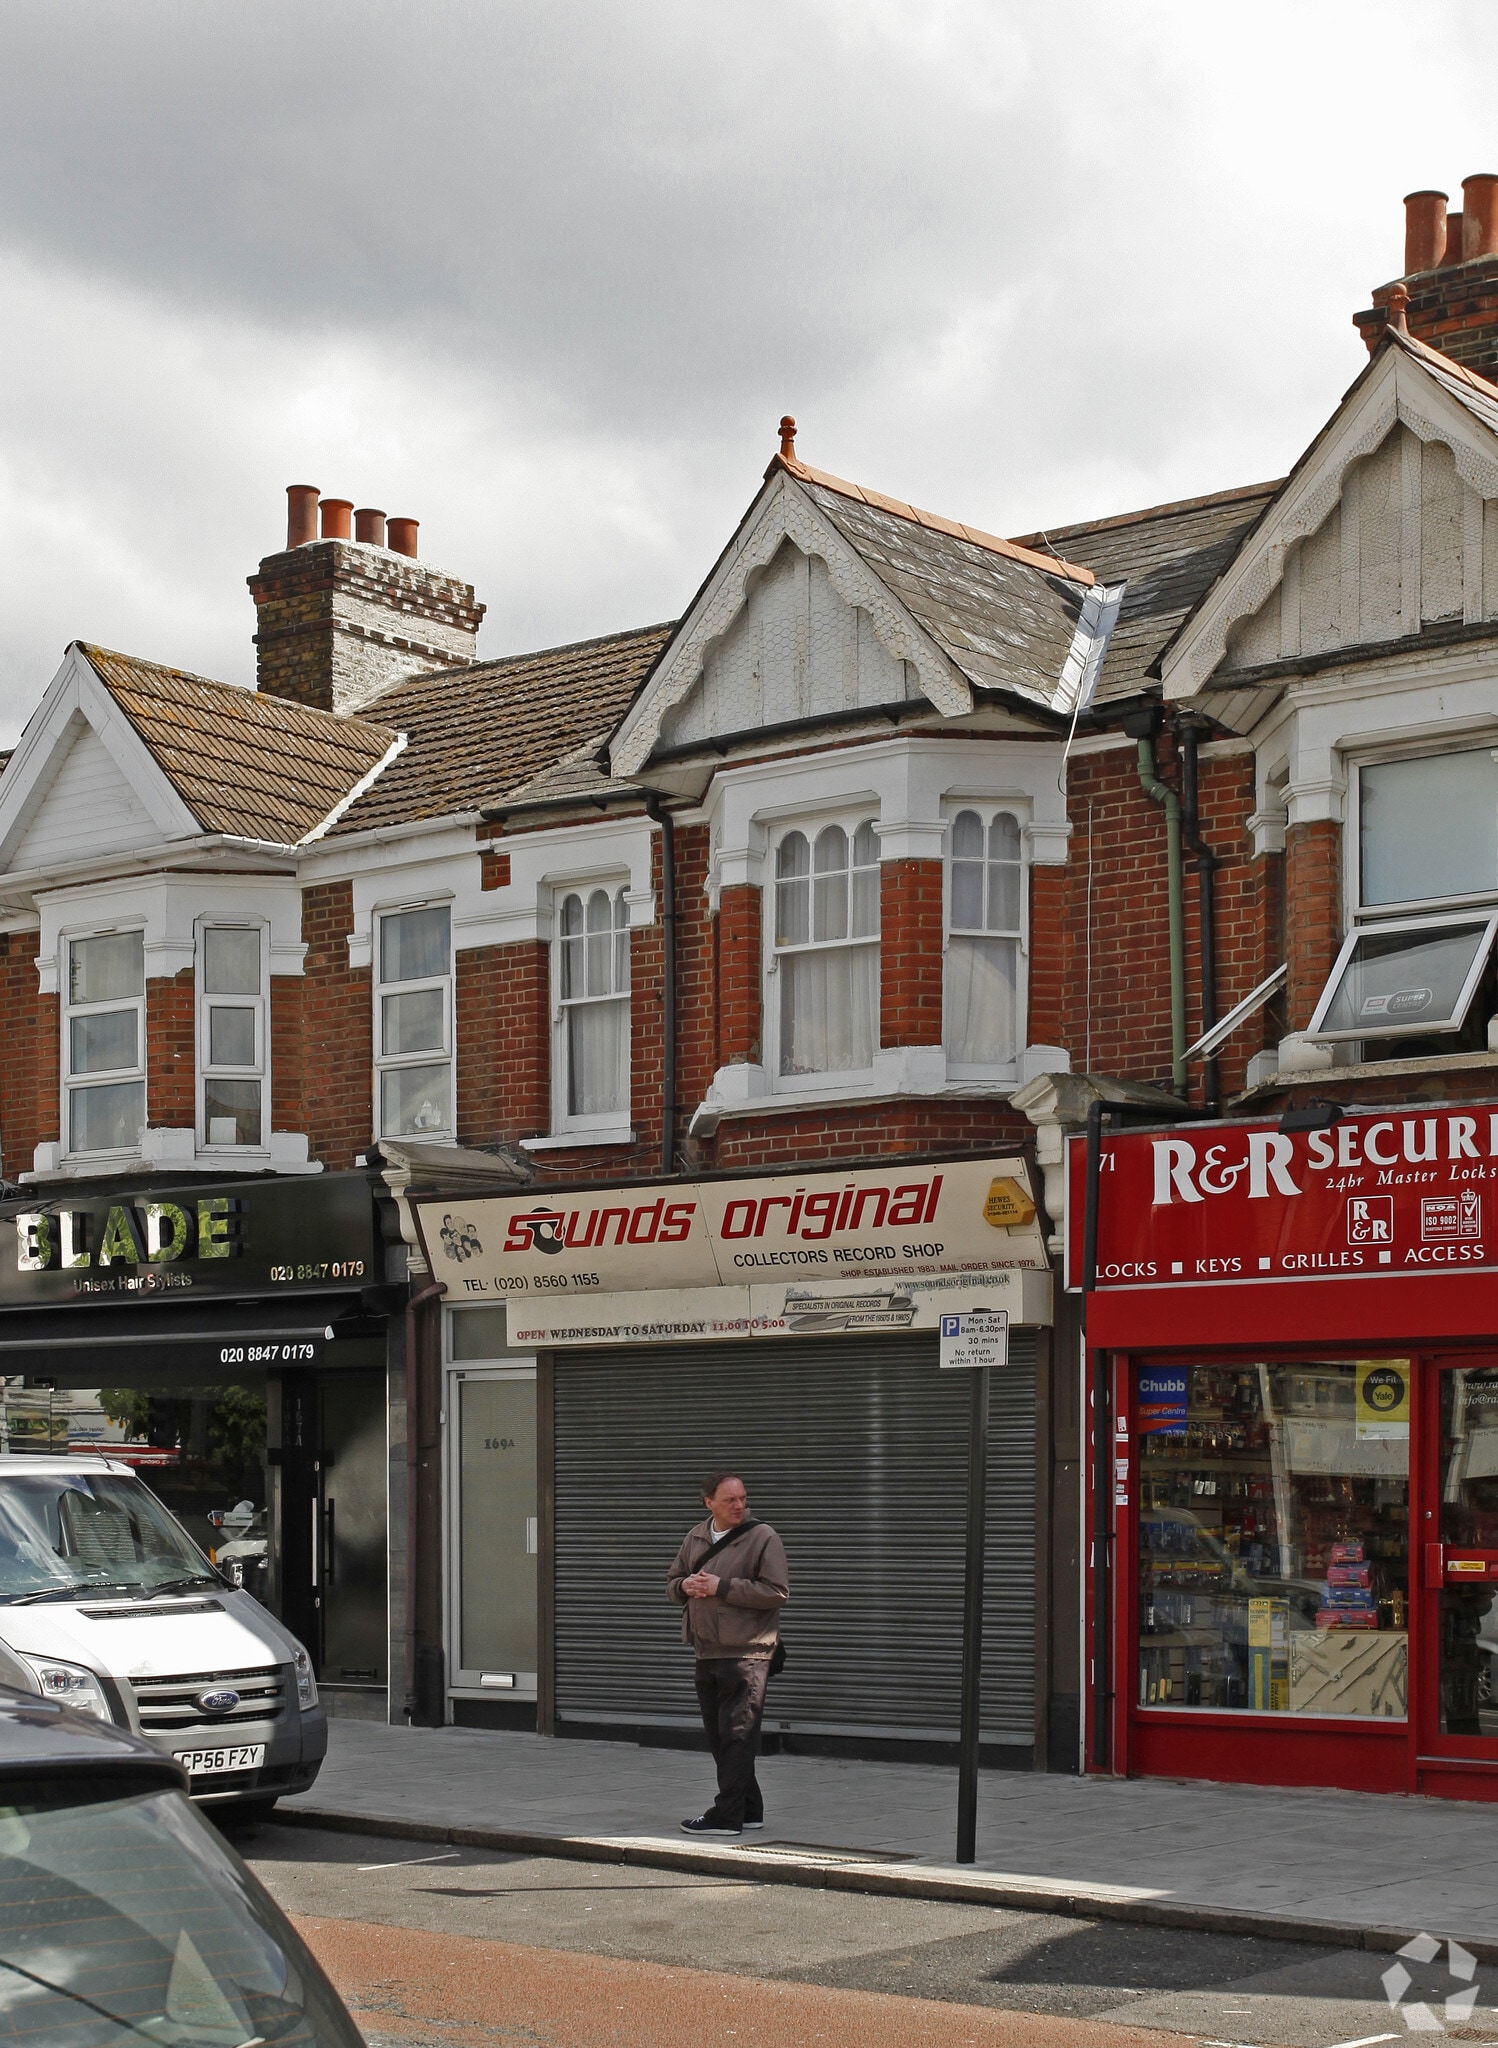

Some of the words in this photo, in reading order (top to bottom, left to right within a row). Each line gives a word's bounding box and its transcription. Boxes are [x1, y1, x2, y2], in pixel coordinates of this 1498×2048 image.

[1396, 993, 1425, 1003] SUPER
[1152, 1132, 1303, 1205] R&R
[1326, 1173, 1364, 1193] 24hr
[1376, 1169, 1437, 1186] Master
[720, 1174, 944, 1240] original
[1353, 1201, 1370, 1221] R
[1426, 1216, 1438, 1226] ISO
[1440, 1215, 1457, 1225] 9002
[16, 1197, 236, 1271] BLADE
[733, 1249, 828, 1268] COLLECTORS
[834, 1246, 896, 1262] RECORD
[902, 1243, 945, 1258] SHOP
[1096, 1261, 1157, 1278] LOCKS
[1196, 1257, 1242, 1273] KEYS
[1281, 1250, 1364, 1269] GRILLES
[1404, 1244, 1485, 1263] ACCESS
[270, 1265, 293, 1281] 020
[297, 1263, 328, 1280] 8847
[332, 1261, 365, 1278] 0179
[840, 1268, 861, 1278] SHOP
[864, 1265, 914, 1277] ESTABLISHED
[940, 1263, 959, 1272] MAIL
[961, 1261, 989, 1271] ORDER
[991, 1260, 1015, 1269] SINCE
[118, 1275, 145, 1290] Hair
[494, 1275, 528, 1290] (020)
[534, 1274, 568, 1288] 8560
[571, 1273, 600, 1287] 1155
[896, 1275, 1010, 1290] www.soundsoriginal.co.uk
[792, 1301, 823, 1311] SPECIALISTS
[824, 1301, 830, 1309] IN
[831, 1300, 854, 1309] ORIGINAL
[856, 1299, 881, 1308] RECORDS
[849, 1314, 864, 1323] FROM
[864, 1314, 875, 1322] THE
[517, 1330, 546, 1340] OPEN
[550, 1326, 621, 1339] WEDNESDAY
[623, 1325, 640, 1336] TO
[641, 1322, 705, 1335] SATURDAY
[712, 1320, 741, 1331] 11.00
[743, 1319, 759, 1329] TO
[761, 1318, 785, 1328] 5.00
[220, 1347, 243, 1363] 020
[247, 1345, 279, 1362] 8847
[282, 1343, 314, 1360] 0179
[949, 1357, 971, 1365] within
[1139, 1379, 1186, 1392] Chubb
[1370, 1376, 1384, 1384] We
[1385, 1375, 1397, 1384] Fit
[1375, 1391, 1393, 1401] Yale
[1138, 1407, 1161, 1416] Super
[1161, 1407, 1186, 1415] Centre
[484, 1438, 515, 1450] 169A
[212, 1694, 235, 1706] Ford
[181, 1750, 224, 1771] CP56
[229, 1747, 259, 1765] FZY
